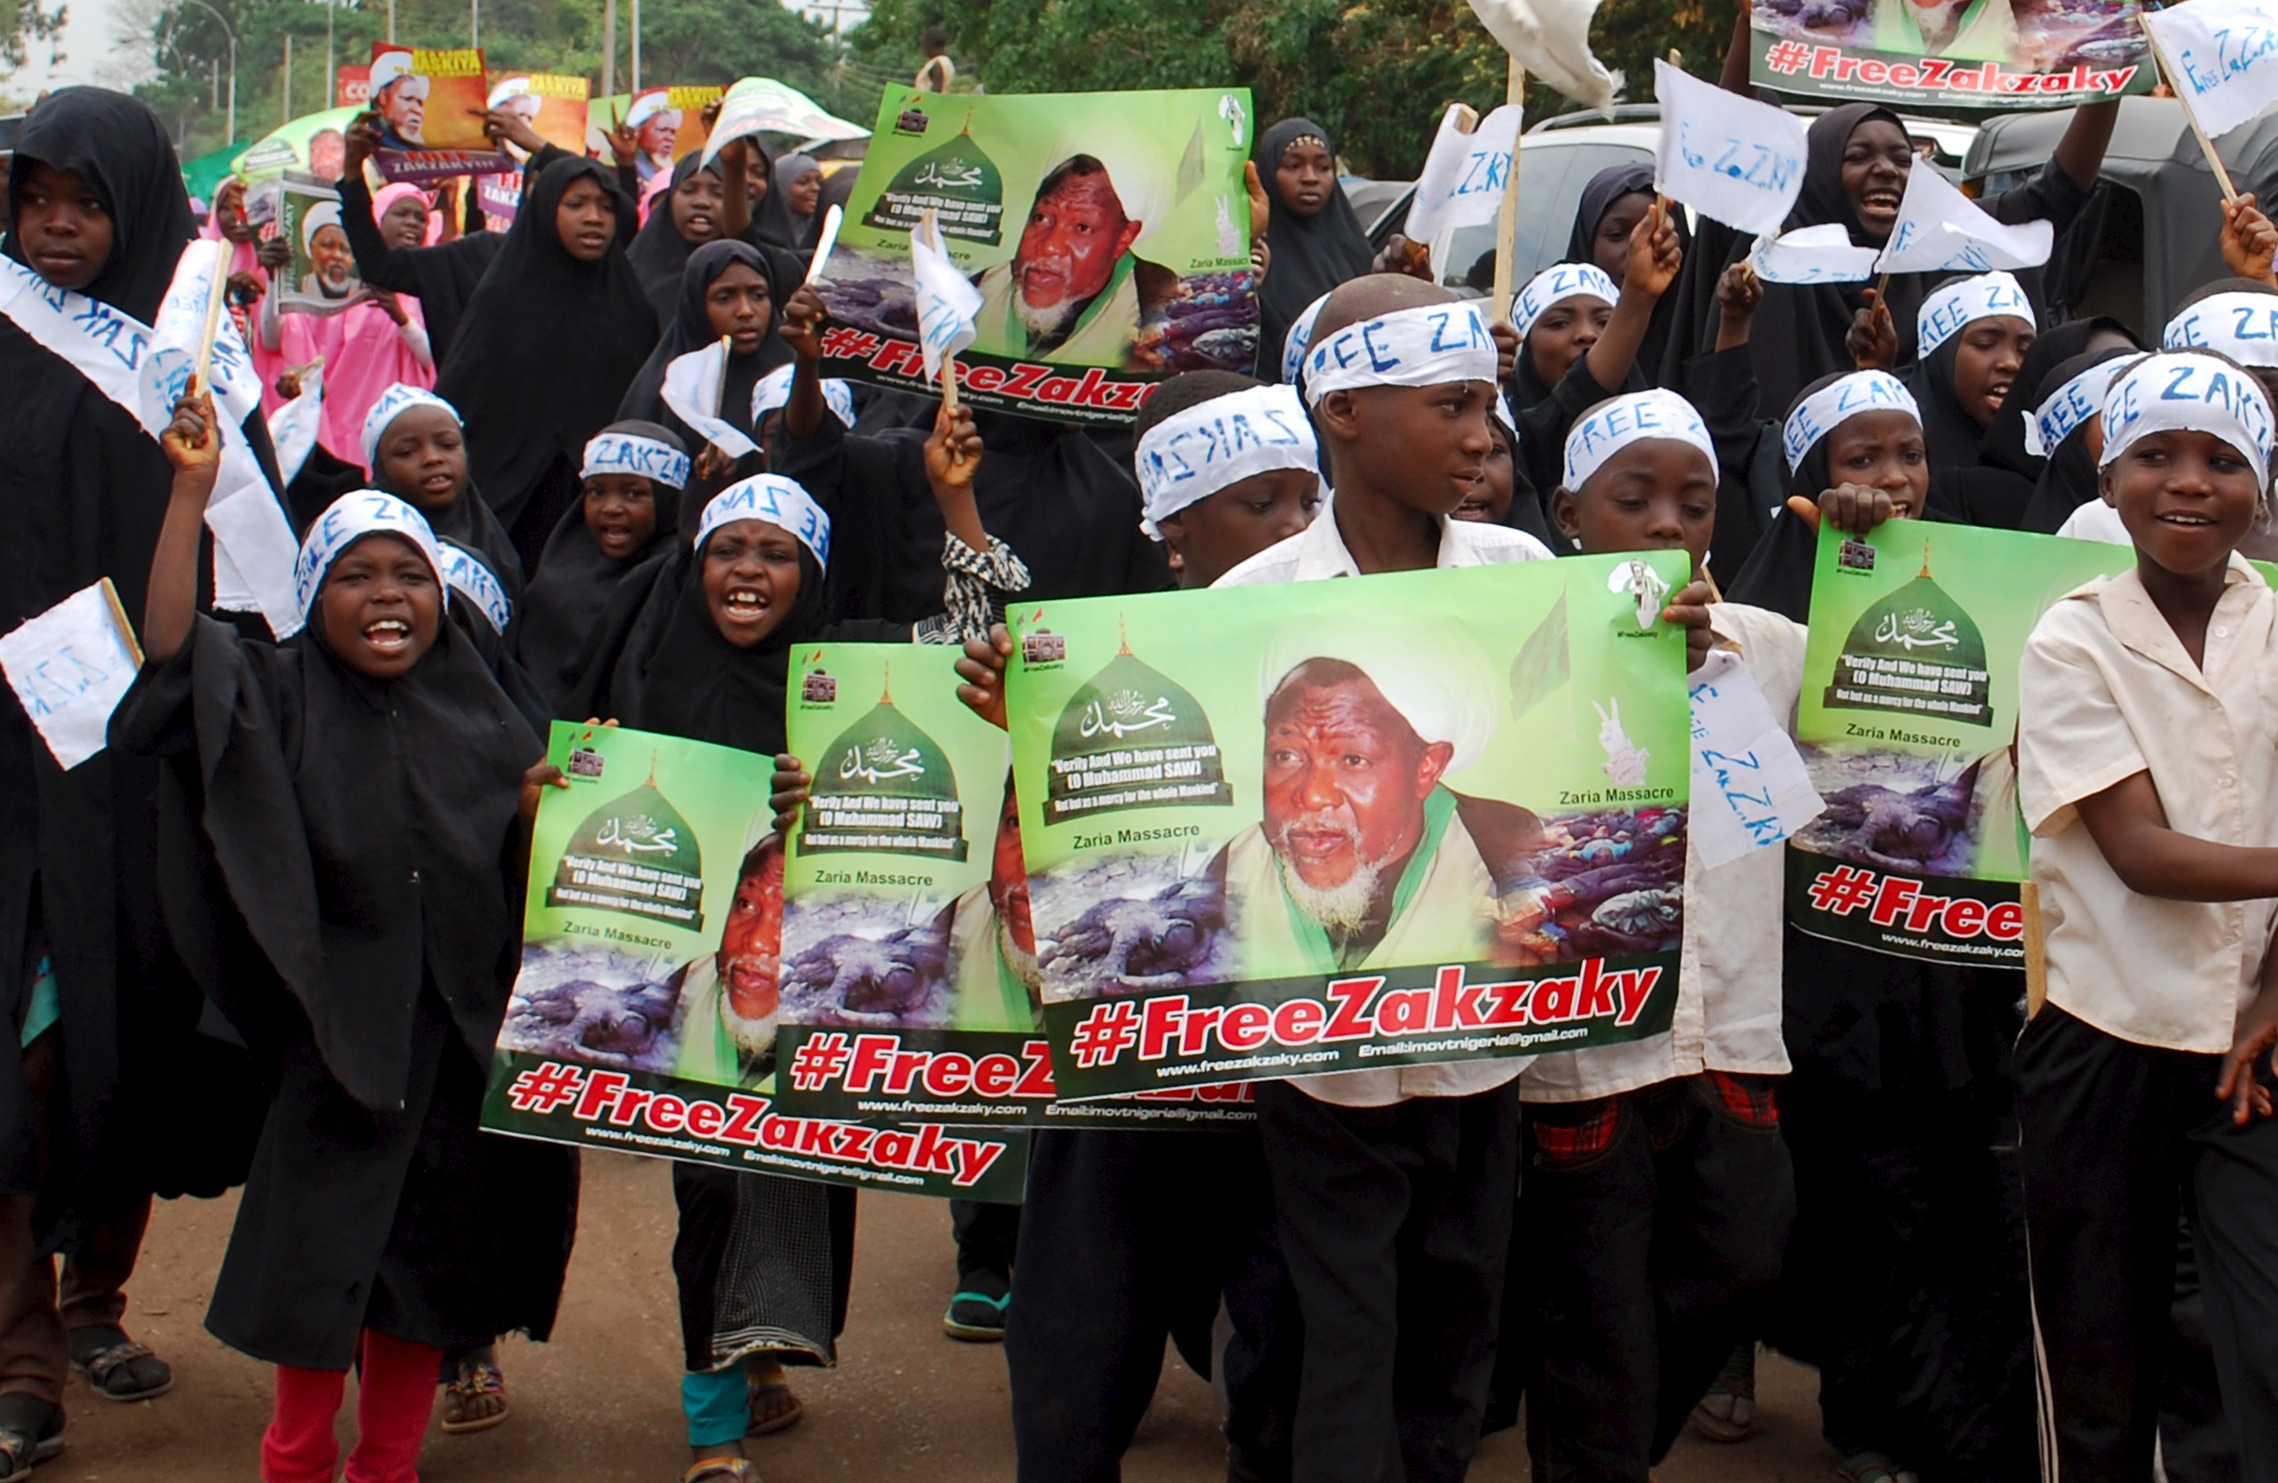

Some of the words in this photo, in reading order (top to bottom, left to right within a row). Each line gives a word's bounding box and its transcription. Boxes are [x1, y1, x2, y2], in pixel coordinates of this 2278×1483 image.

[1766, 39, 2139, 95] #FreeZakzaky
[1568, 401, 1662, 478] FREE
[1877, 658, 1898, 672] And
[1899, 660, 1916, 674] We
[1917, 662, 1942, 677] have
[1943, 666, 1967, 680] sent
[1968, 670, 1987, 681] you
[1868, 672, 1939, 692] Muhammad
[1846, 723, 1884, 740] Zaria
[1889, 729, 1961, 748] Massacre
[1089, 753, 1111, 768] And
[1112, 751, 1132, 766] We
[1133, 749, 1163, 763] have
[1165, 746, 1192, 760] sent
[1193, 744, 1217, 759] you
[1082, 763, 1162, 787] Muhammad
[842, 796, 862, 809] And
[863, 796, 880, 810] We
[881, 796, 908, 810] have
[909, 799, 936, 811] sent
[937, 801, 959, 813] you
[1560, 791, 1600, 805] Zaria
[1605, 787, 1674, 802] Massacre
[834, 811, 905, 827] Muhammad
[1073, 832, 1112, 850] Zaria
[1117, 823, 1200, 844] Massacre
[815, 870, 852, 884] Zaria
[855, 871, 933, 886] Massacre
[563, 921, 600, 937] Zaria
[604, 927, 673, 950] Massacre
[1070, 957, 1663, 1069] #FreeZakzaky
[1156, 1050, 1340, 1078] www.freezakzaky.com
[1358, 1026, 1588, 1058] Email:imovtnigeria@gmail.com
[857, 1099, 1027, 1117] www.freezakzaky.com
[507, 1061, 1007, 1187] #FreeZakzaky
